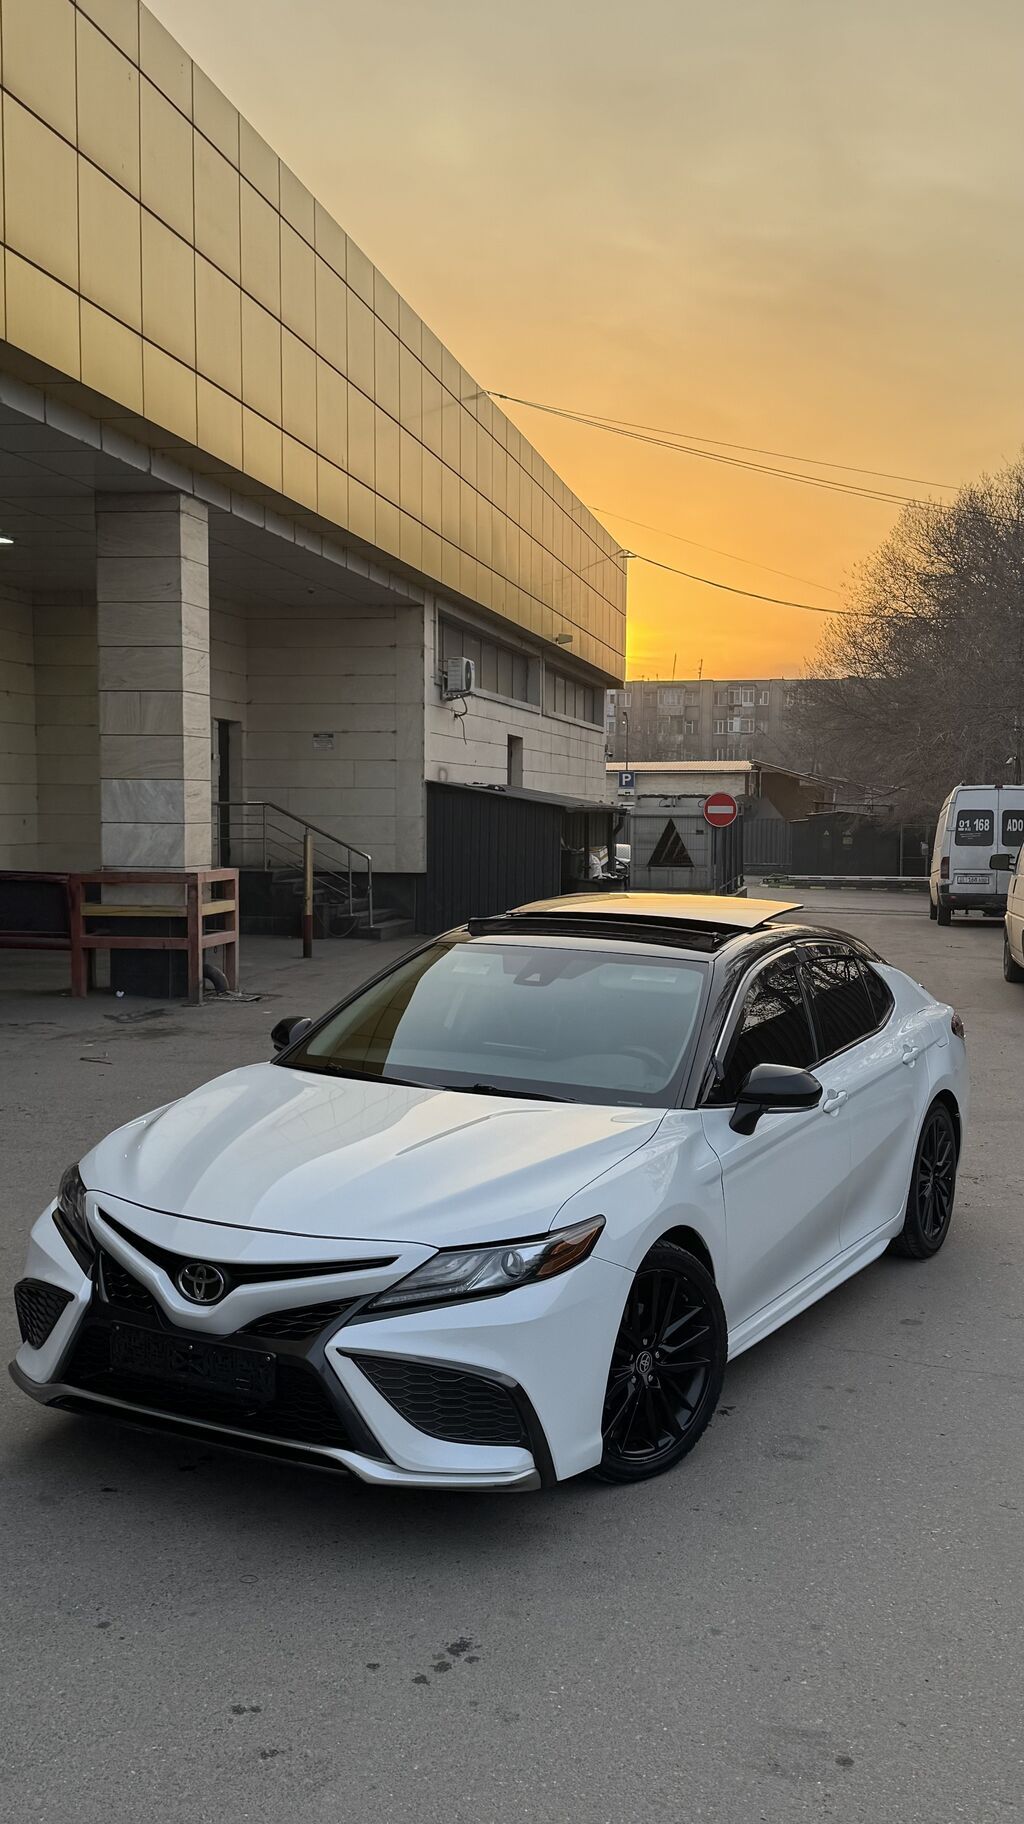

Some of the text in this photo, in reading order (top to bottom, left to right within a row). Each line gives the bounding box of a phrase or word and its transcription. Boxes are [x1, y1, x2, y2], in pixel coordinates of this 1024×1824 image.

[622, 773, 632, 786] P
[958, 820, 970, 828] 01
[973, 818, 990, 831] 168
